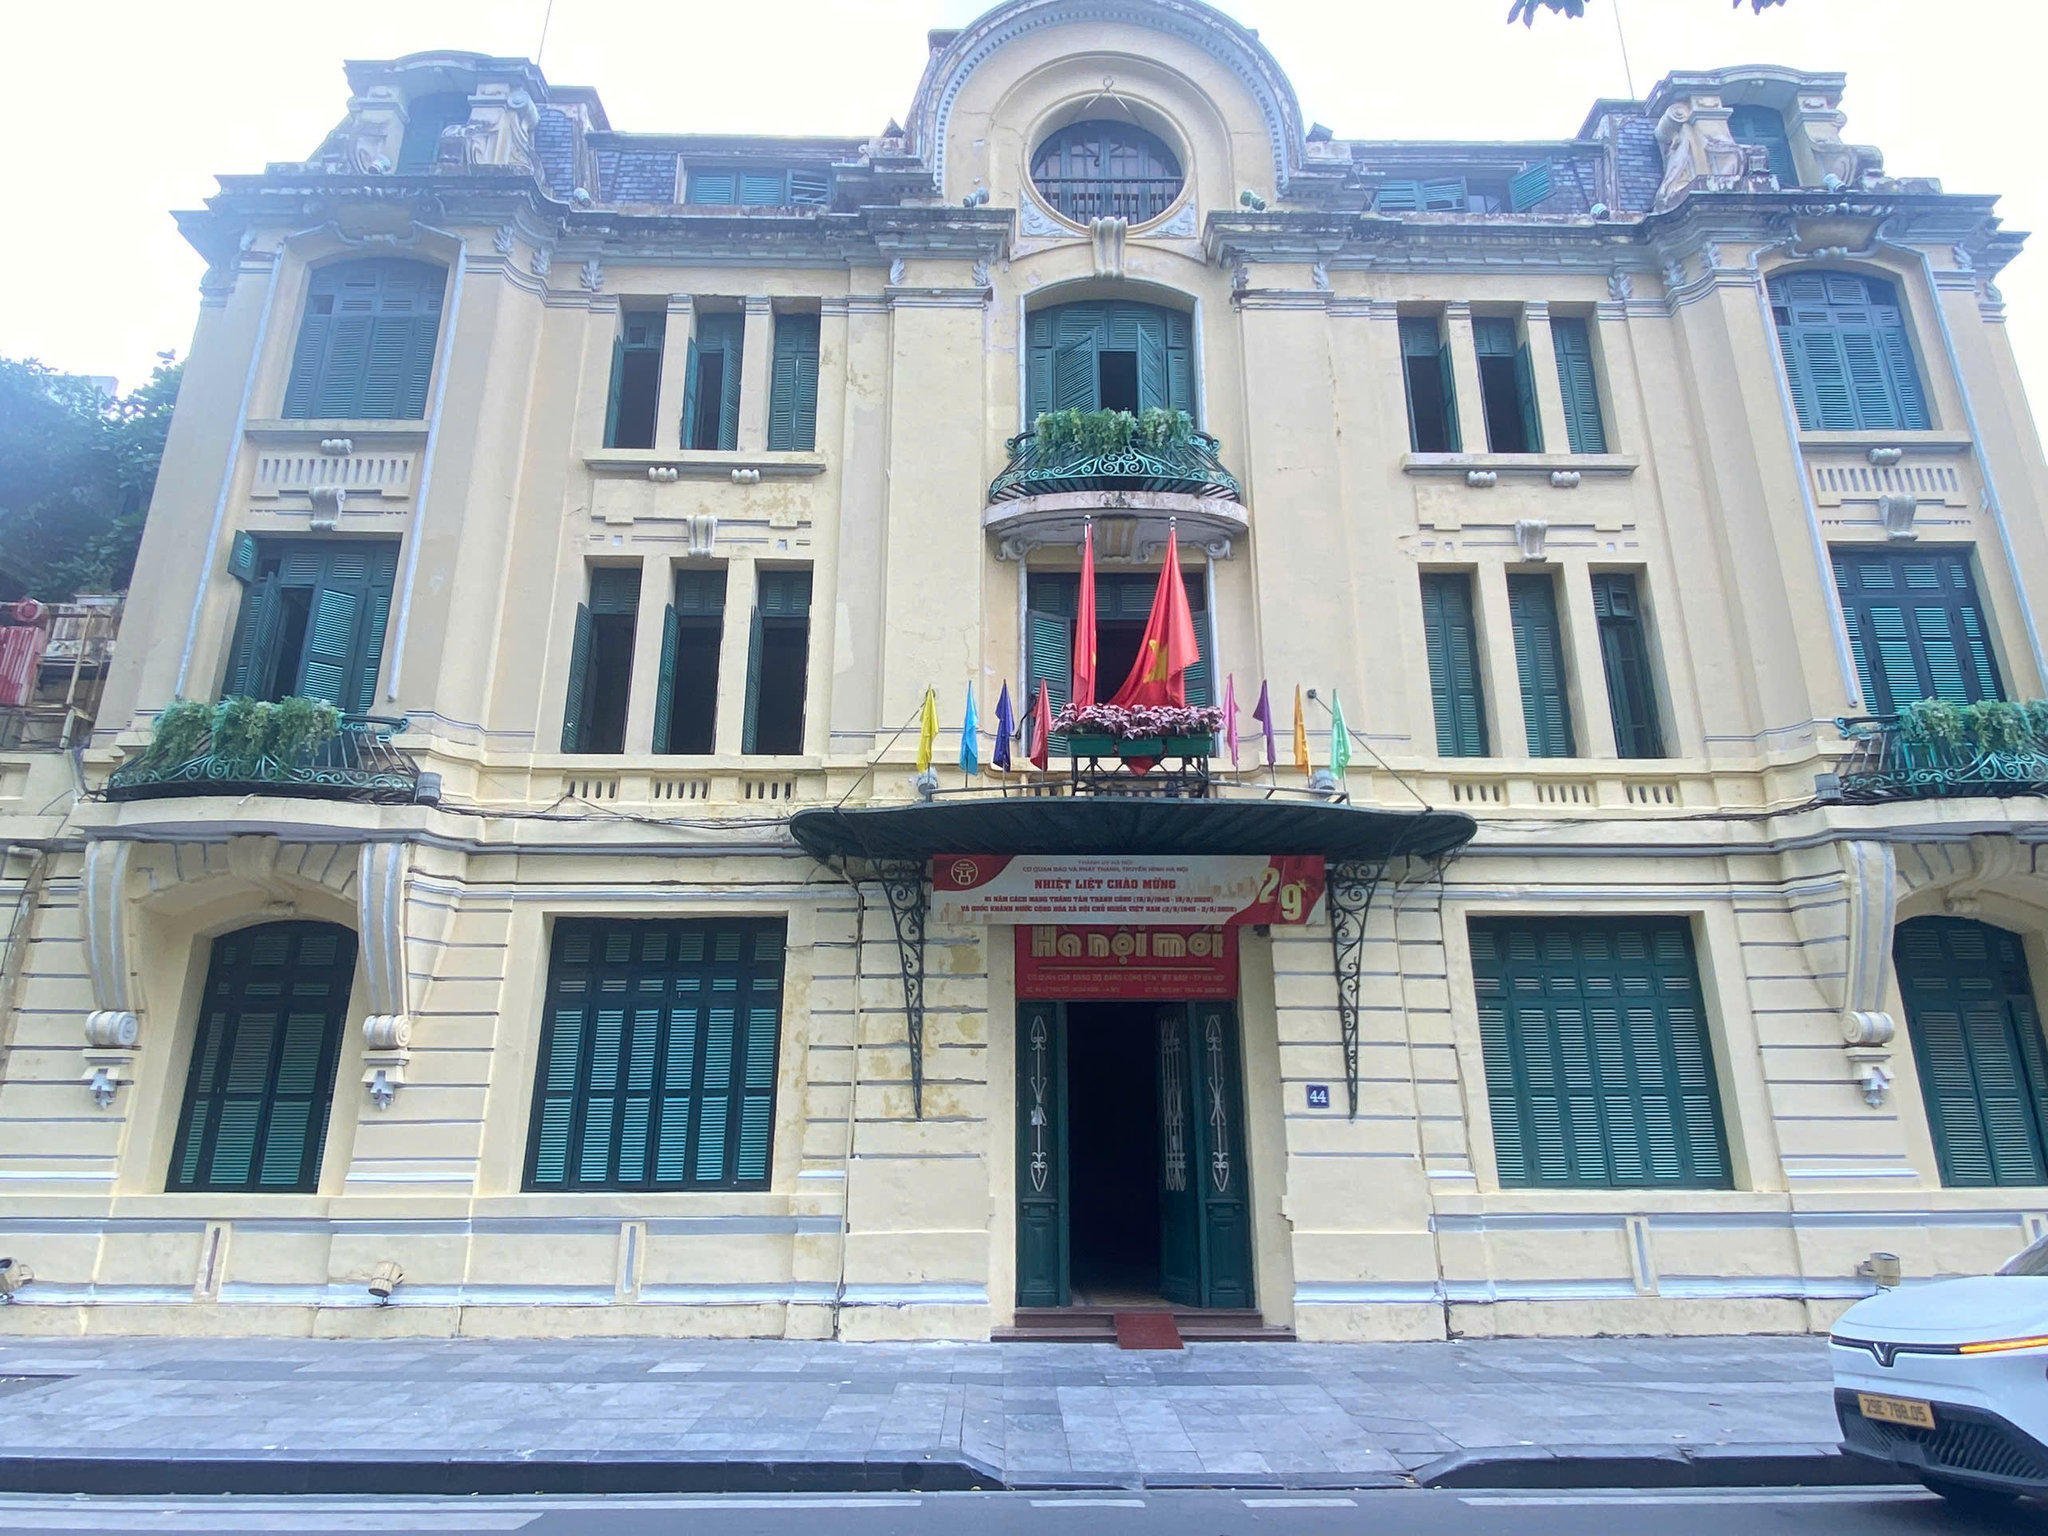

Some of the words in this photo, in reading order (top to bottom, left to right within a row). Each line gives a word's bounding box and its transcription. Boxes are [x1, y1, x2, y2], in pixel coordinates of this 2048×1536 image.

[1034, 877, 1072, 891] NHIỆT
[1075, 877, 1104, 891] LIỆT
[1107, 877, 1138, 889] CHÀO
[1142, 877, 1176, 889] MỪNG
[1031, 925, 1082, 957] Hà
[1087, 925, 1147, 964] nội
[1152, 925, 1224, 958] mới
[1309, 1090, 1327, 1103] 44
